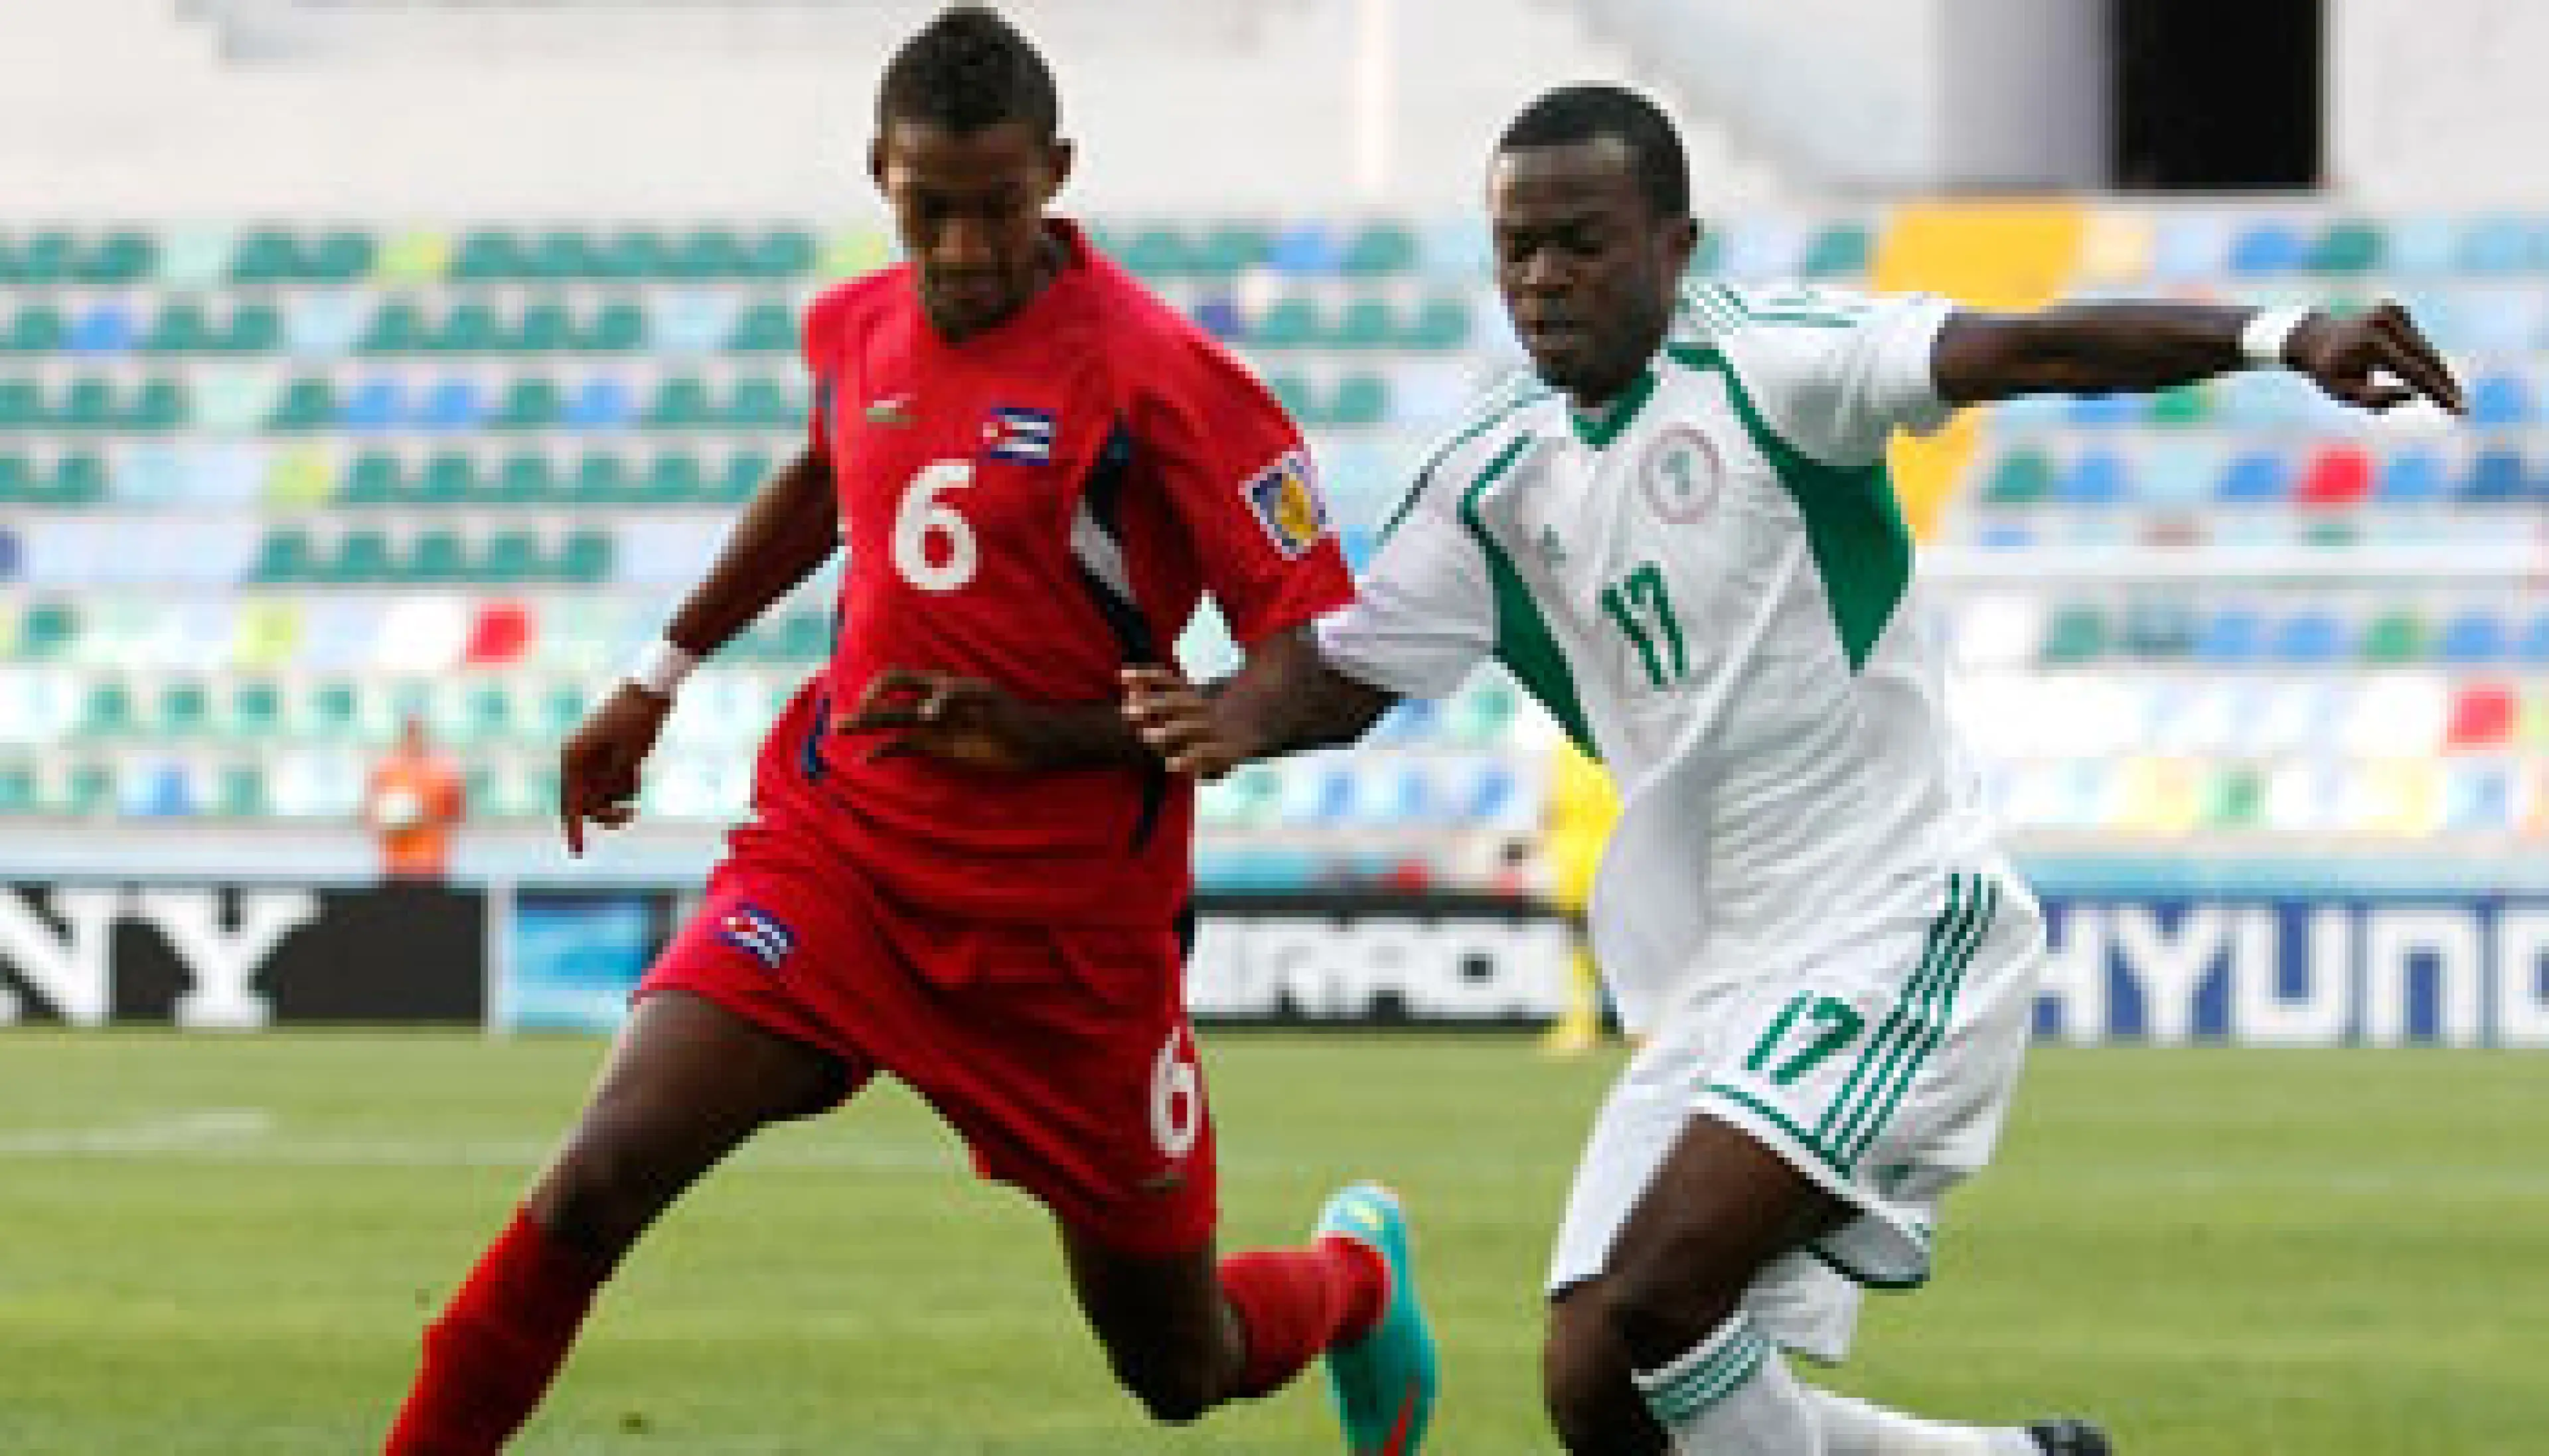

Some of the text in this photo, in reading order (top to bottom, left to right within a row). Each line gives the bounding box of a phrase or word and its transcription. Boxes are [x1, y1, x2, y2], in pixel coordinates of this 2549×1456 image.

[893, 458, 980, 589] 6
[1601, 561, 1689, 690] 17
[1151, 1029, 1200, 1156] 6
[1743, 991, 1864, 1084] 17
